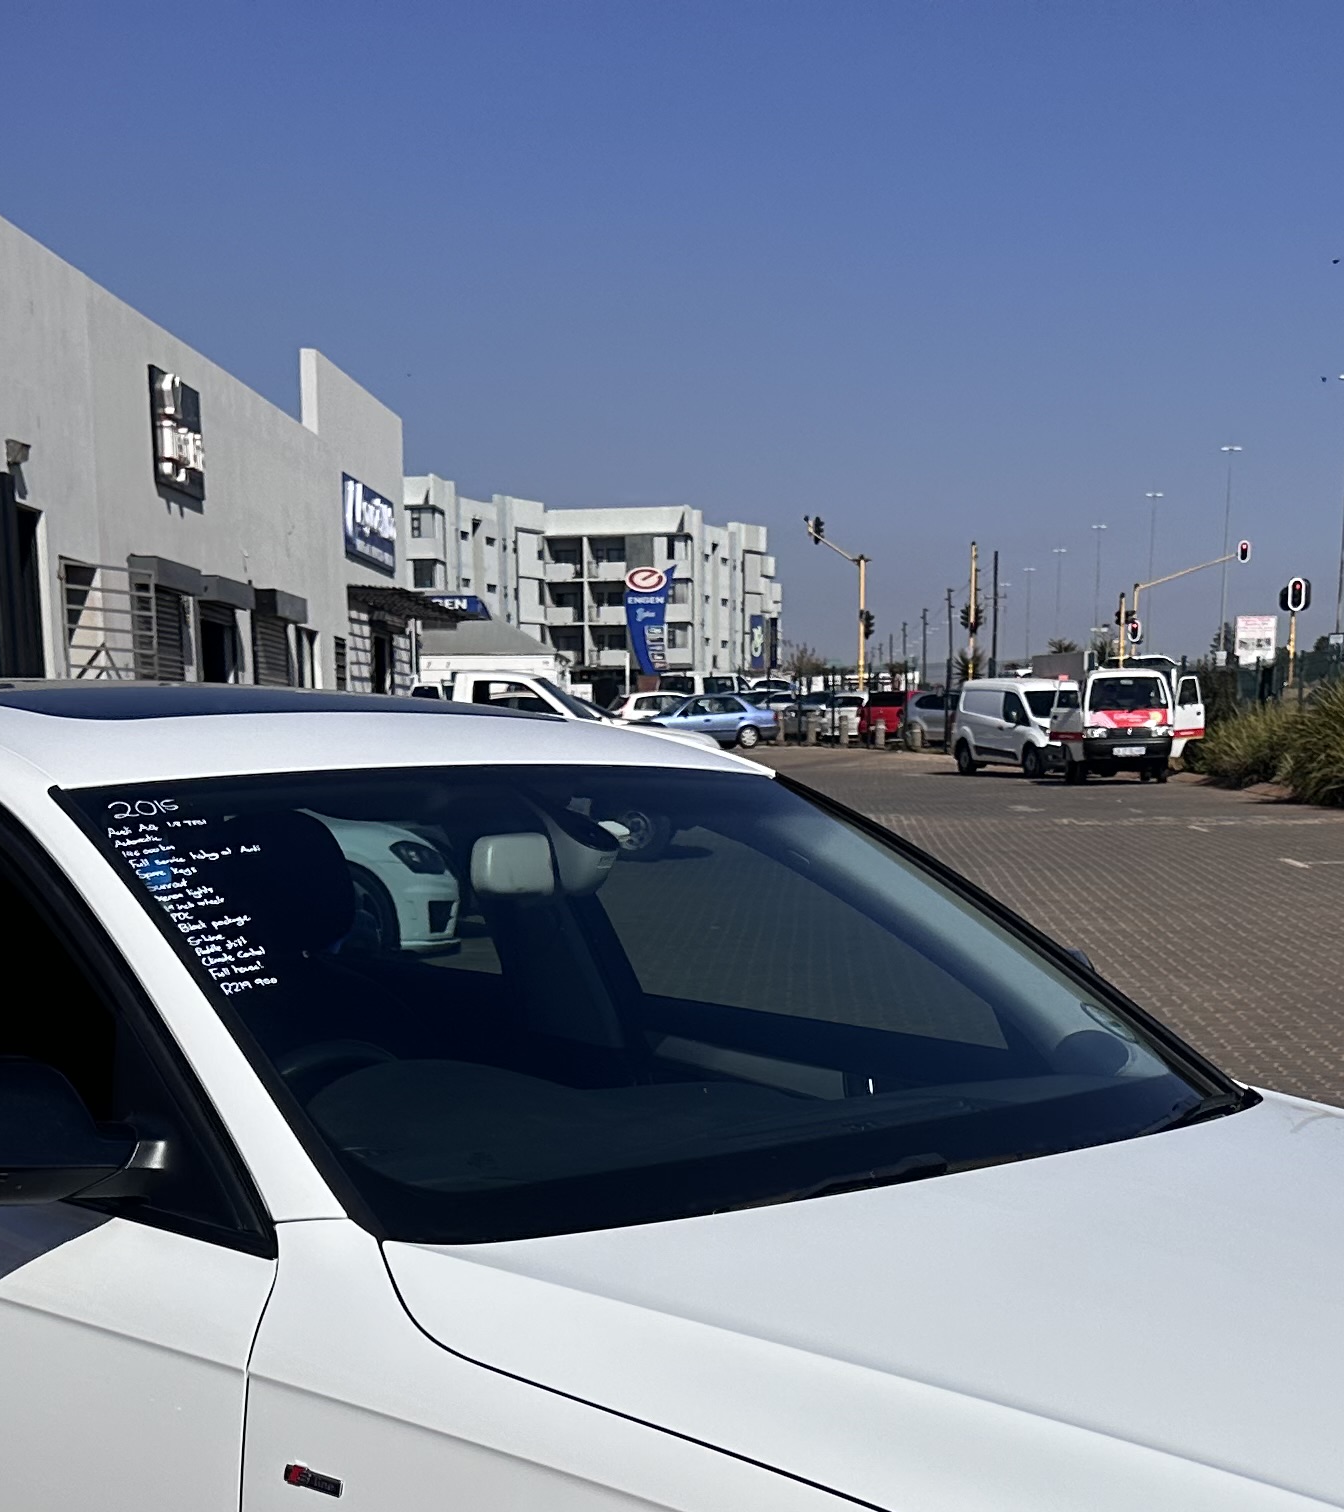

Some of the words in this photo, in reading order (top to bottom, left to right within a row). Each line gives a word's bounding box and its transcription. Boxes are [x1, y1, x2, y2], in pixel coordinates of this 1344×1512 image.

[628, 596, 665, 607] ENGEN
[107, 799, 179, 819] 2015
[128, 859, 150, 869] Full
[170, 912, 194, 922] PDC
[208, 967, 231, 980] Full
[254, 978, 278, 986] 900
